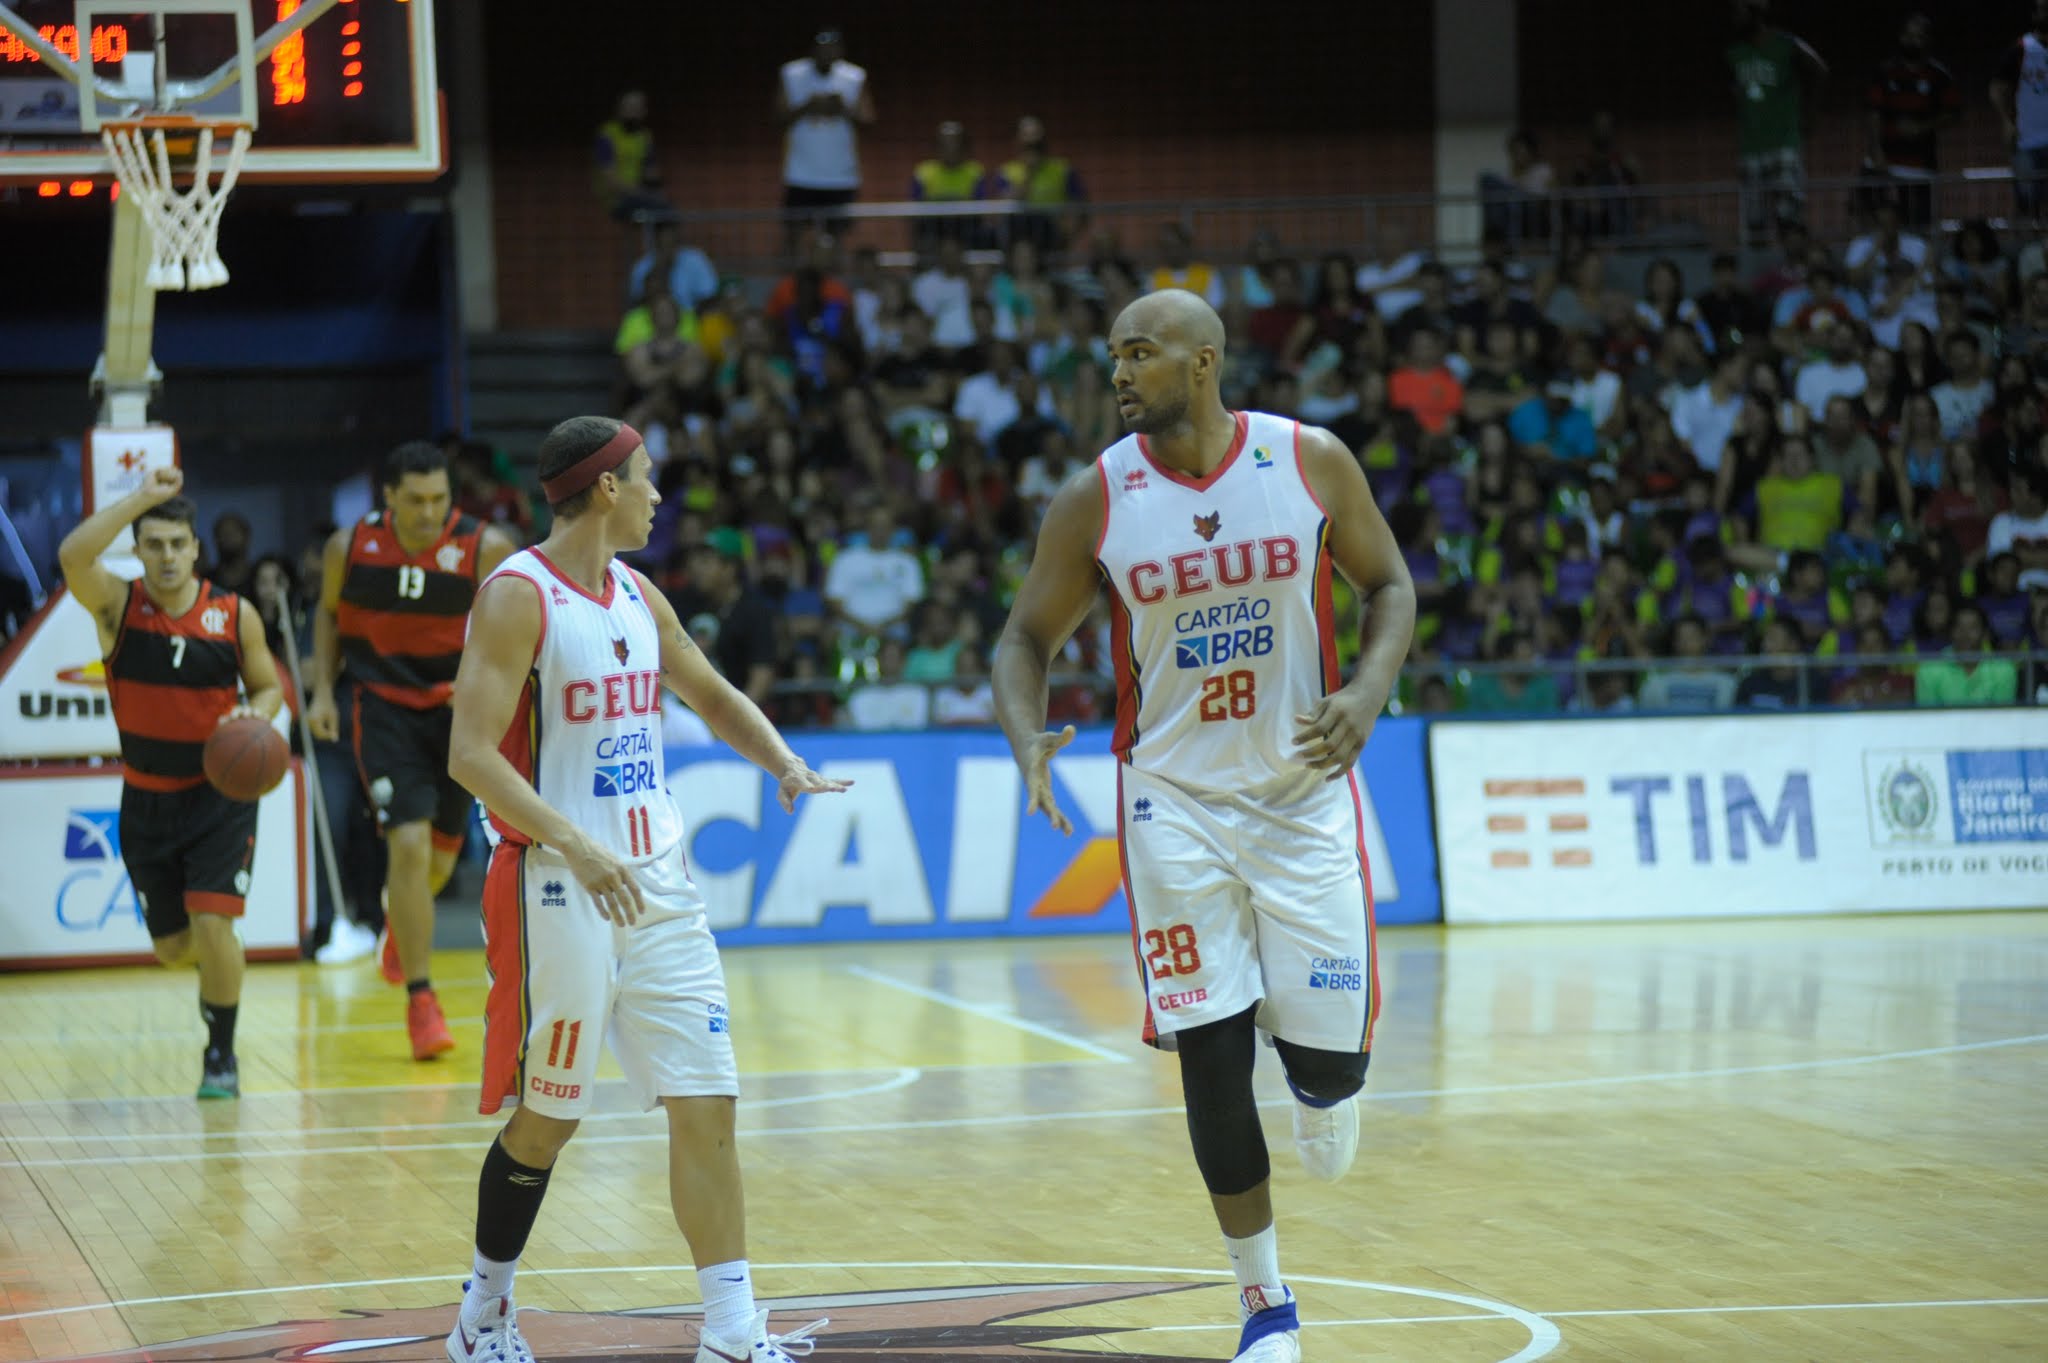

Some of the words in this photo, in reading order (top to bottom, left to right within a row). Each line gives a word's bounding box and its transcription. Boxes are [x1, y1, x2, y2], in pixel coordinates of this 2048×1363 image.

[398, 565, 426, 600] 13
[1126, 535, 1300, 606] CEUB
[1175, 596, 1271, 633] CARTÃO
[169, 635, 187, 670] 7
[1212, 625, 1274, 665] BRB
[19, 692, 106, 721] Uni
[1199, 669, 1256, 722] 28
[627, 804, 652, 858] 11
[1610, 771, 1816, 865] TIM
[541, 896, 567, 907] errea
[1145, 923, 1201, 981] 28
[1311, 956, 1361, 971] CARTÃO
[1158, 987, 1208, 1012] CEUB
[1330, 973, 1362, 991] BRB
[547, 1018, 582, 1070] 11
[530, 1076, 582, 1099] CEUB
